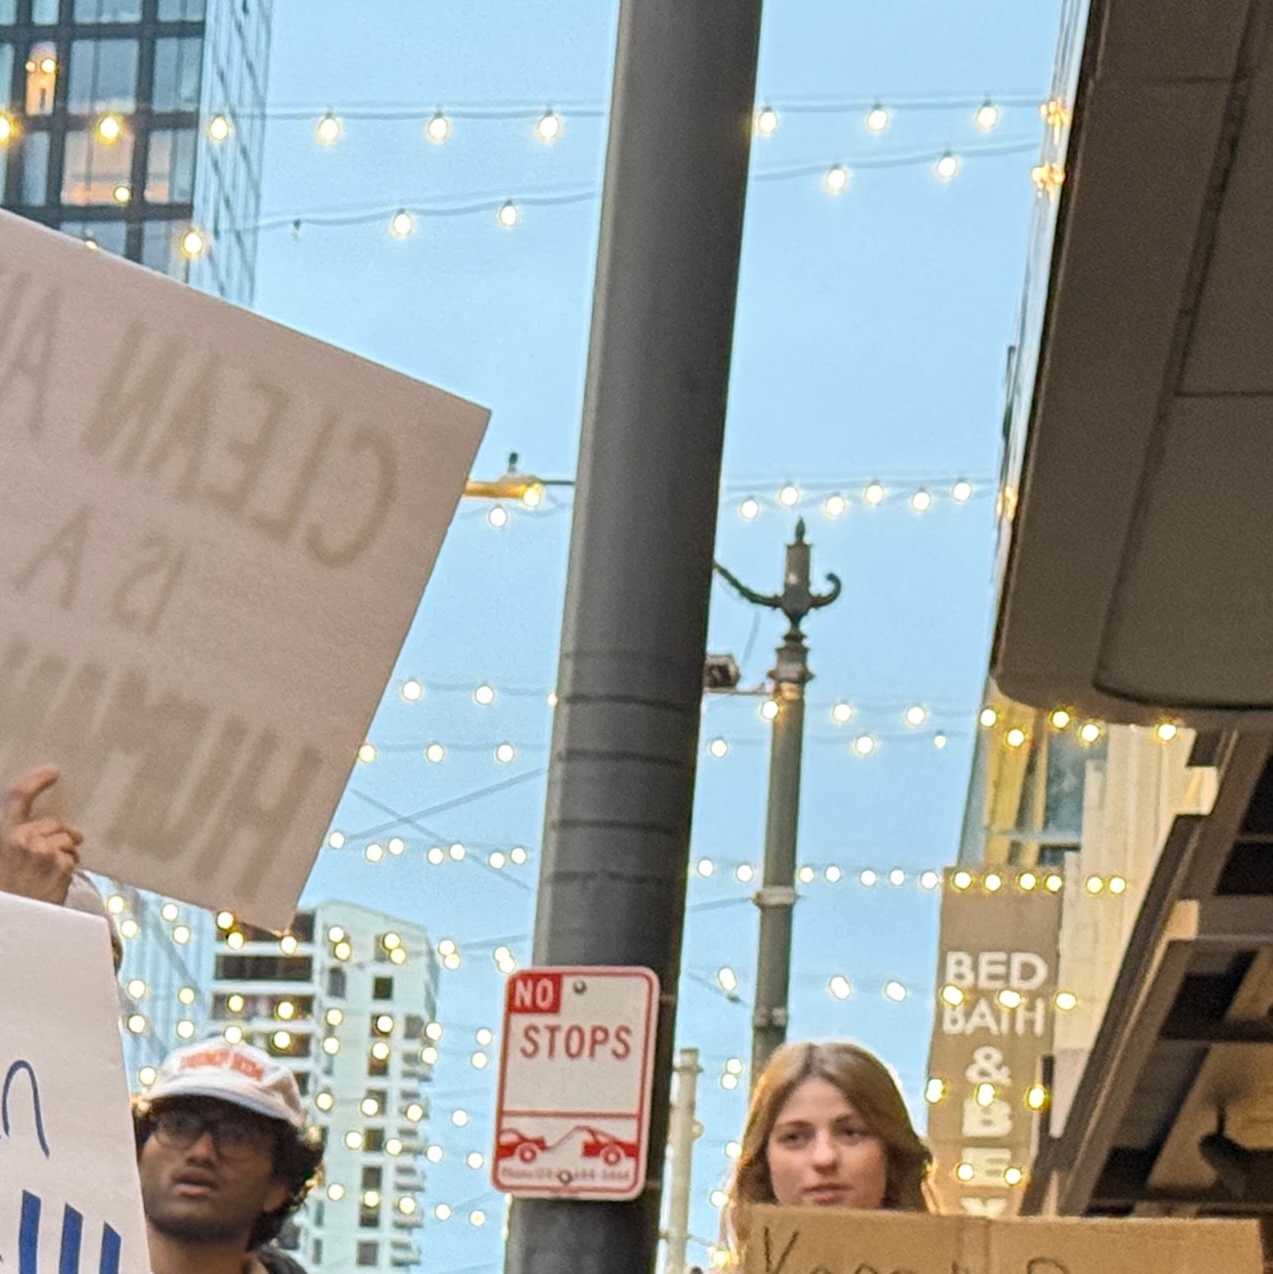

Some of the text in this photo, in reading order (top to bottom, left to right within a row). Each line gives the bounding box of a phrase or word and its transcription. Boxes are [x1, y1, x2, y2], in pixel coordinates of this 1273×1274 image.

[944, 951, 1049, 991] BED
[514, 977, 554, 1010] NO
[941, 996, 1046, 1037] BATH
[519, 1023, 633, 1061] STOPS
[965, 1045, 1012, 1087] &
